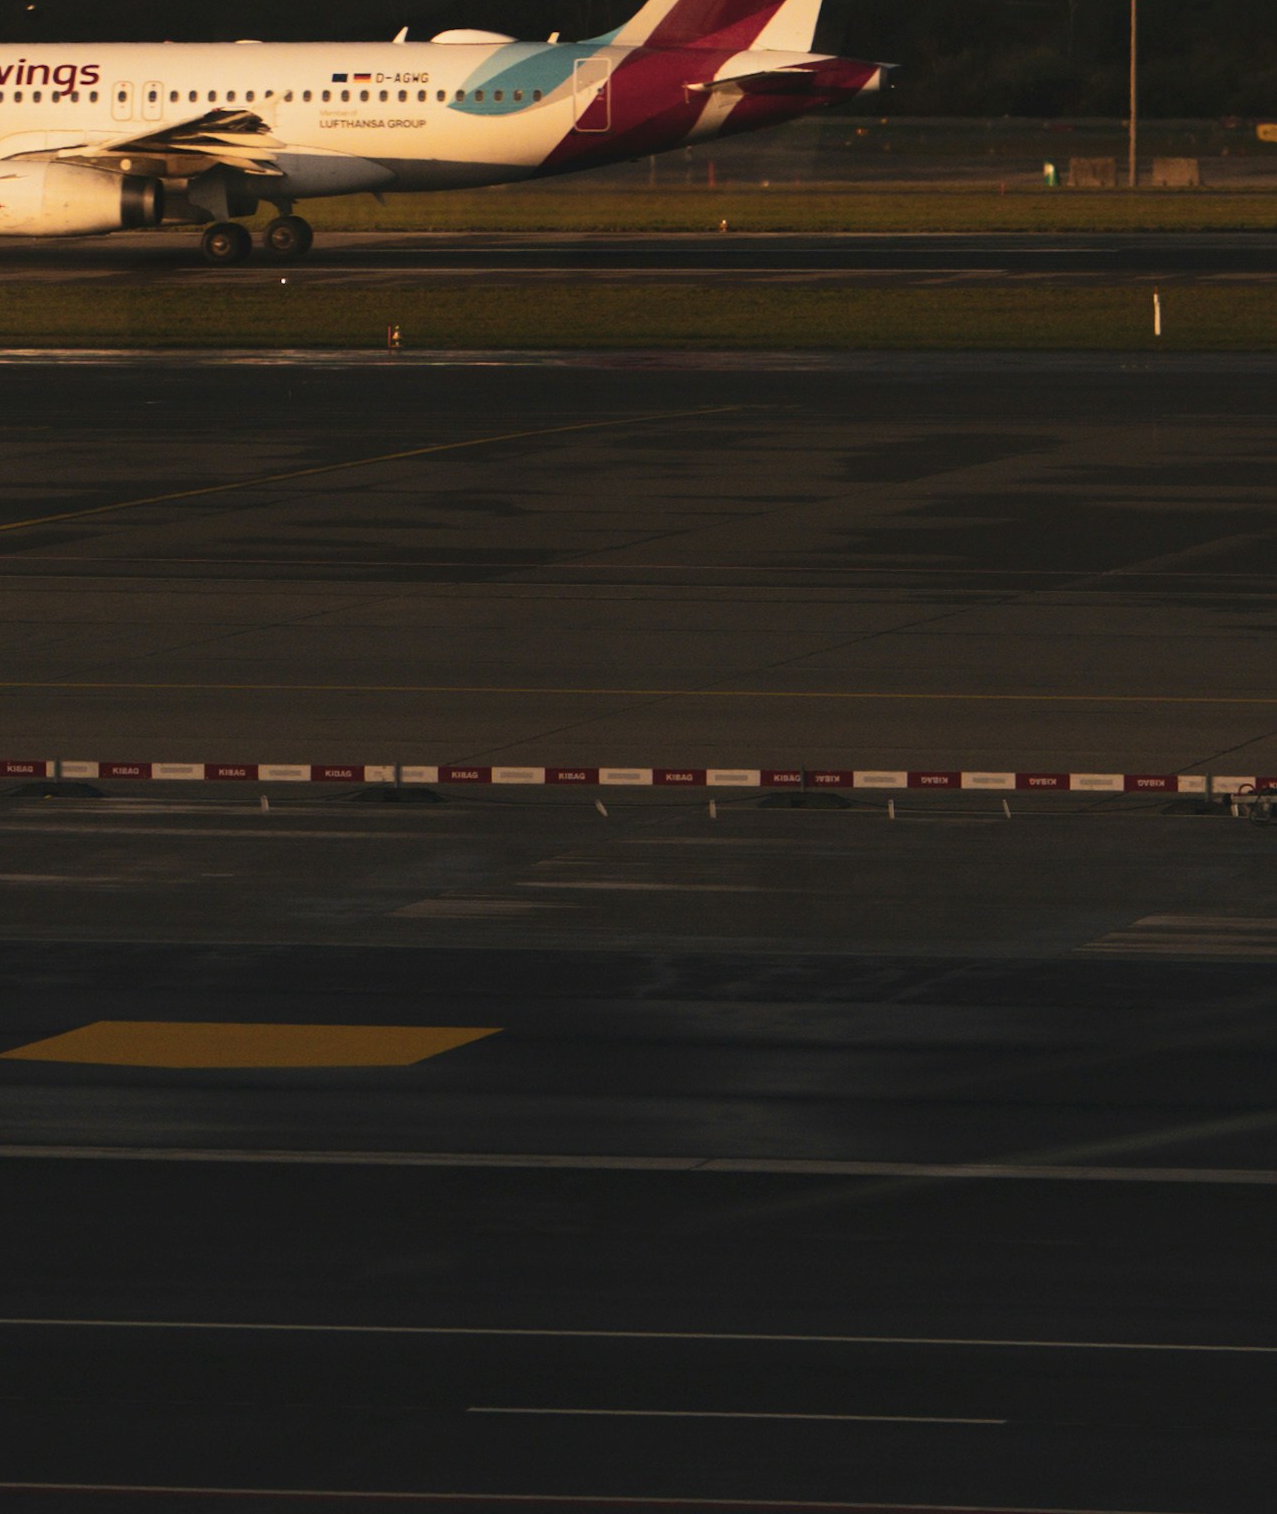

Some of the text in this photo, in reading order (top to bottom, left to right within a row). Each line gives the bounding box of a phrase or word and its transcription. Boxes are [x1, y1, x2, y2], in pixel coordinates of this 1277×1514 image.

[375, 73, 430, 84] D-AGWG
[319, 119, 427, 129] LUFTHANSA GROUP
[6, 765, 34, 773] KIBAG
[112, 767, 140, 775] KIBAG
[218, 768, 246, 777] KIBAG
[324, 770, 353, 778] KIBAG
[451, 771, 479, 779] KIBAG
[558, 772, 586, 780] KIBAG
[665, 773, 694, 782] KIBAG
[773, 774, 802, 782] KIBAG
